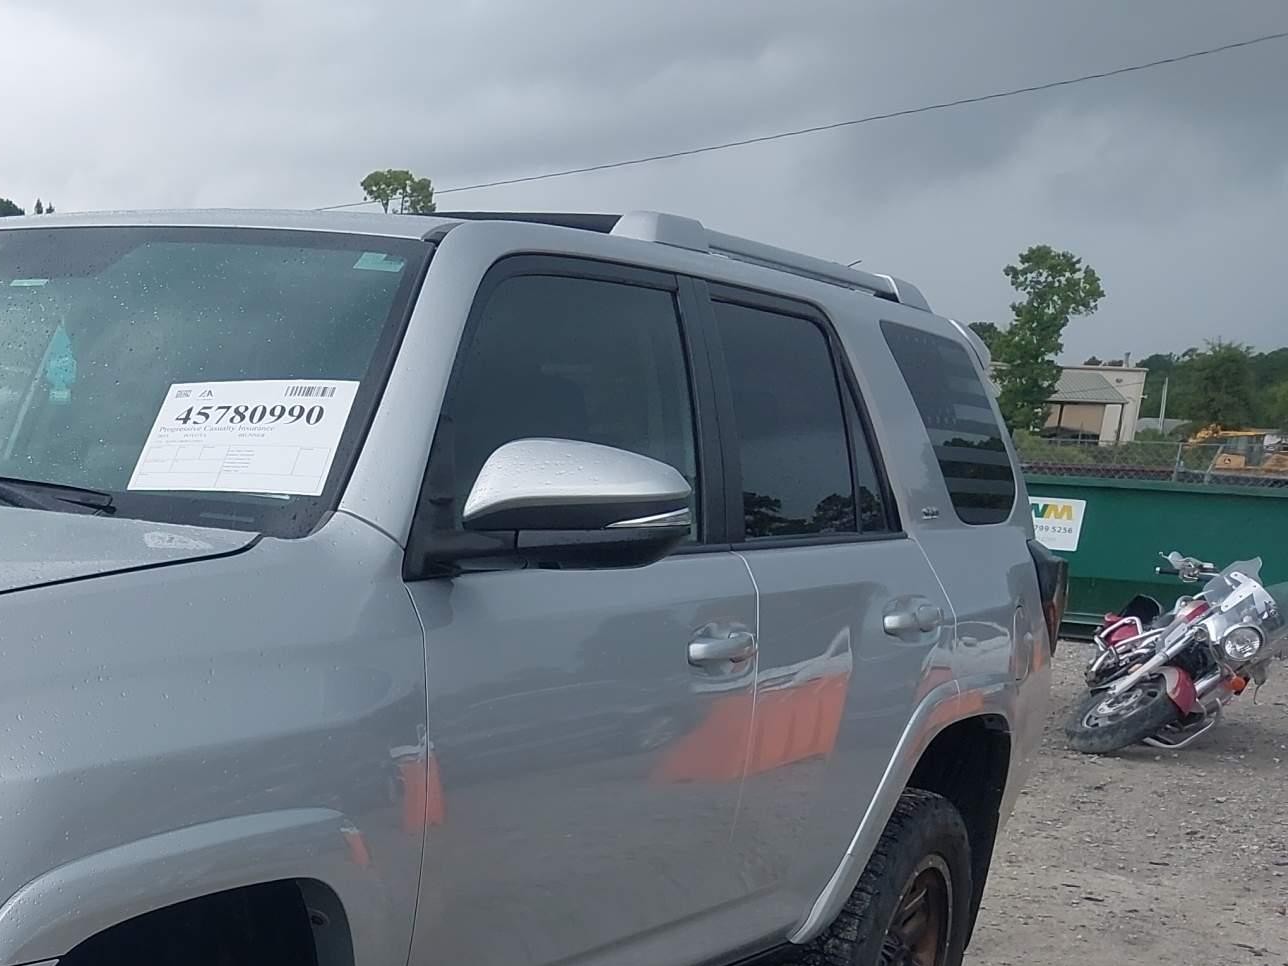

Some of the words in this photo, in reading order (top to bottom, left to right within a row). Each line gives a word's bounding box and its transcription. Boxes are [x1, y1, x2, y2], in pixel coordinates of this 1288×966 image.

[174, 404, 325, 426] 45780990
[203, 425, 236, 433] Casualty
[238, 424, 275, 432] Insurance
